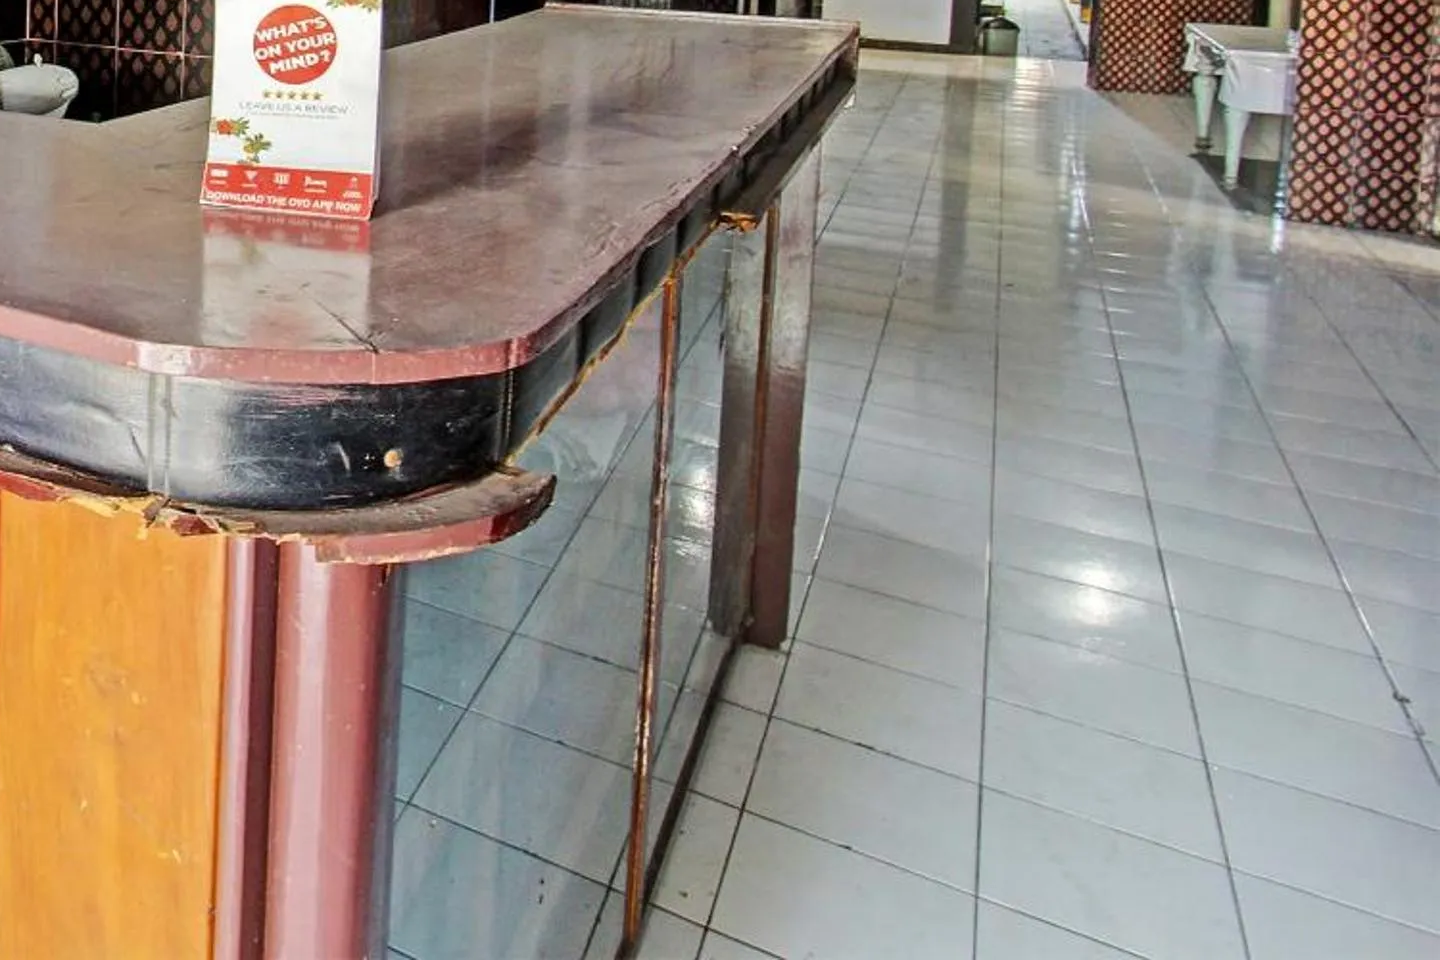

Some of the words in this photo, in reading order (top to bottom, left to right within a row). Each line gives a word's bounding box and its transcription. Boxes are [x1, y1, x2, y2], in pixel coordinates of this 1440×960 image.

[256, 16, 327, 43] WHAT'S
[255, 43, 282, 61] ON
[283, 32, 335, 53] YOUR
[269, 49, 331, 74] MIND?
[304, 103, 349, 115] REVIEW
[205, 189, 265, 205] DOWNLOAD
[266, 194, 287, 207] THE
[312, 198, 334, 213] APP
[334, 201, 362, 214] NOW
